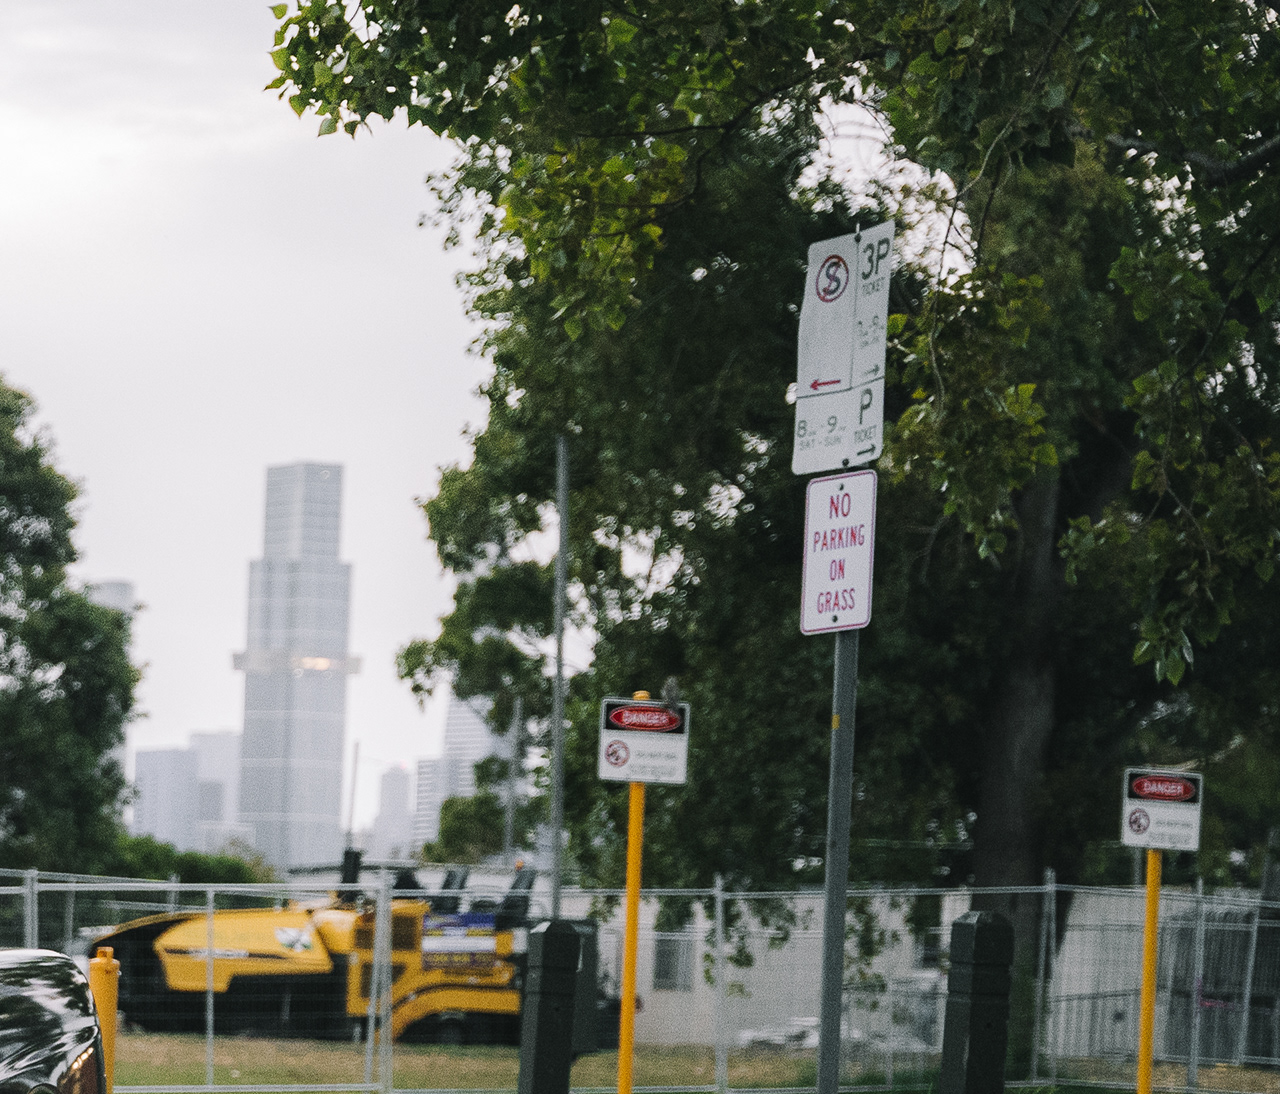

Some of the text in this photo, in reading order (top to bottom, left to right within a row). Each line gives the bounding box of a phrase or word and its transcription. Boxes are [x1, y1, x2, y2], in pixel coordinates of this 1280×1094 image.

[861, 236, 890, 281] 3P
[859, 387, 873, 425] P
[829, 492, 851, 519] NO
[813, 524, 865, 553] PARKING
[829, 559, 846, 581] ON
[817, 588, 855, 614] GRASS
[1142, 780, 1184, 795] DANGER
